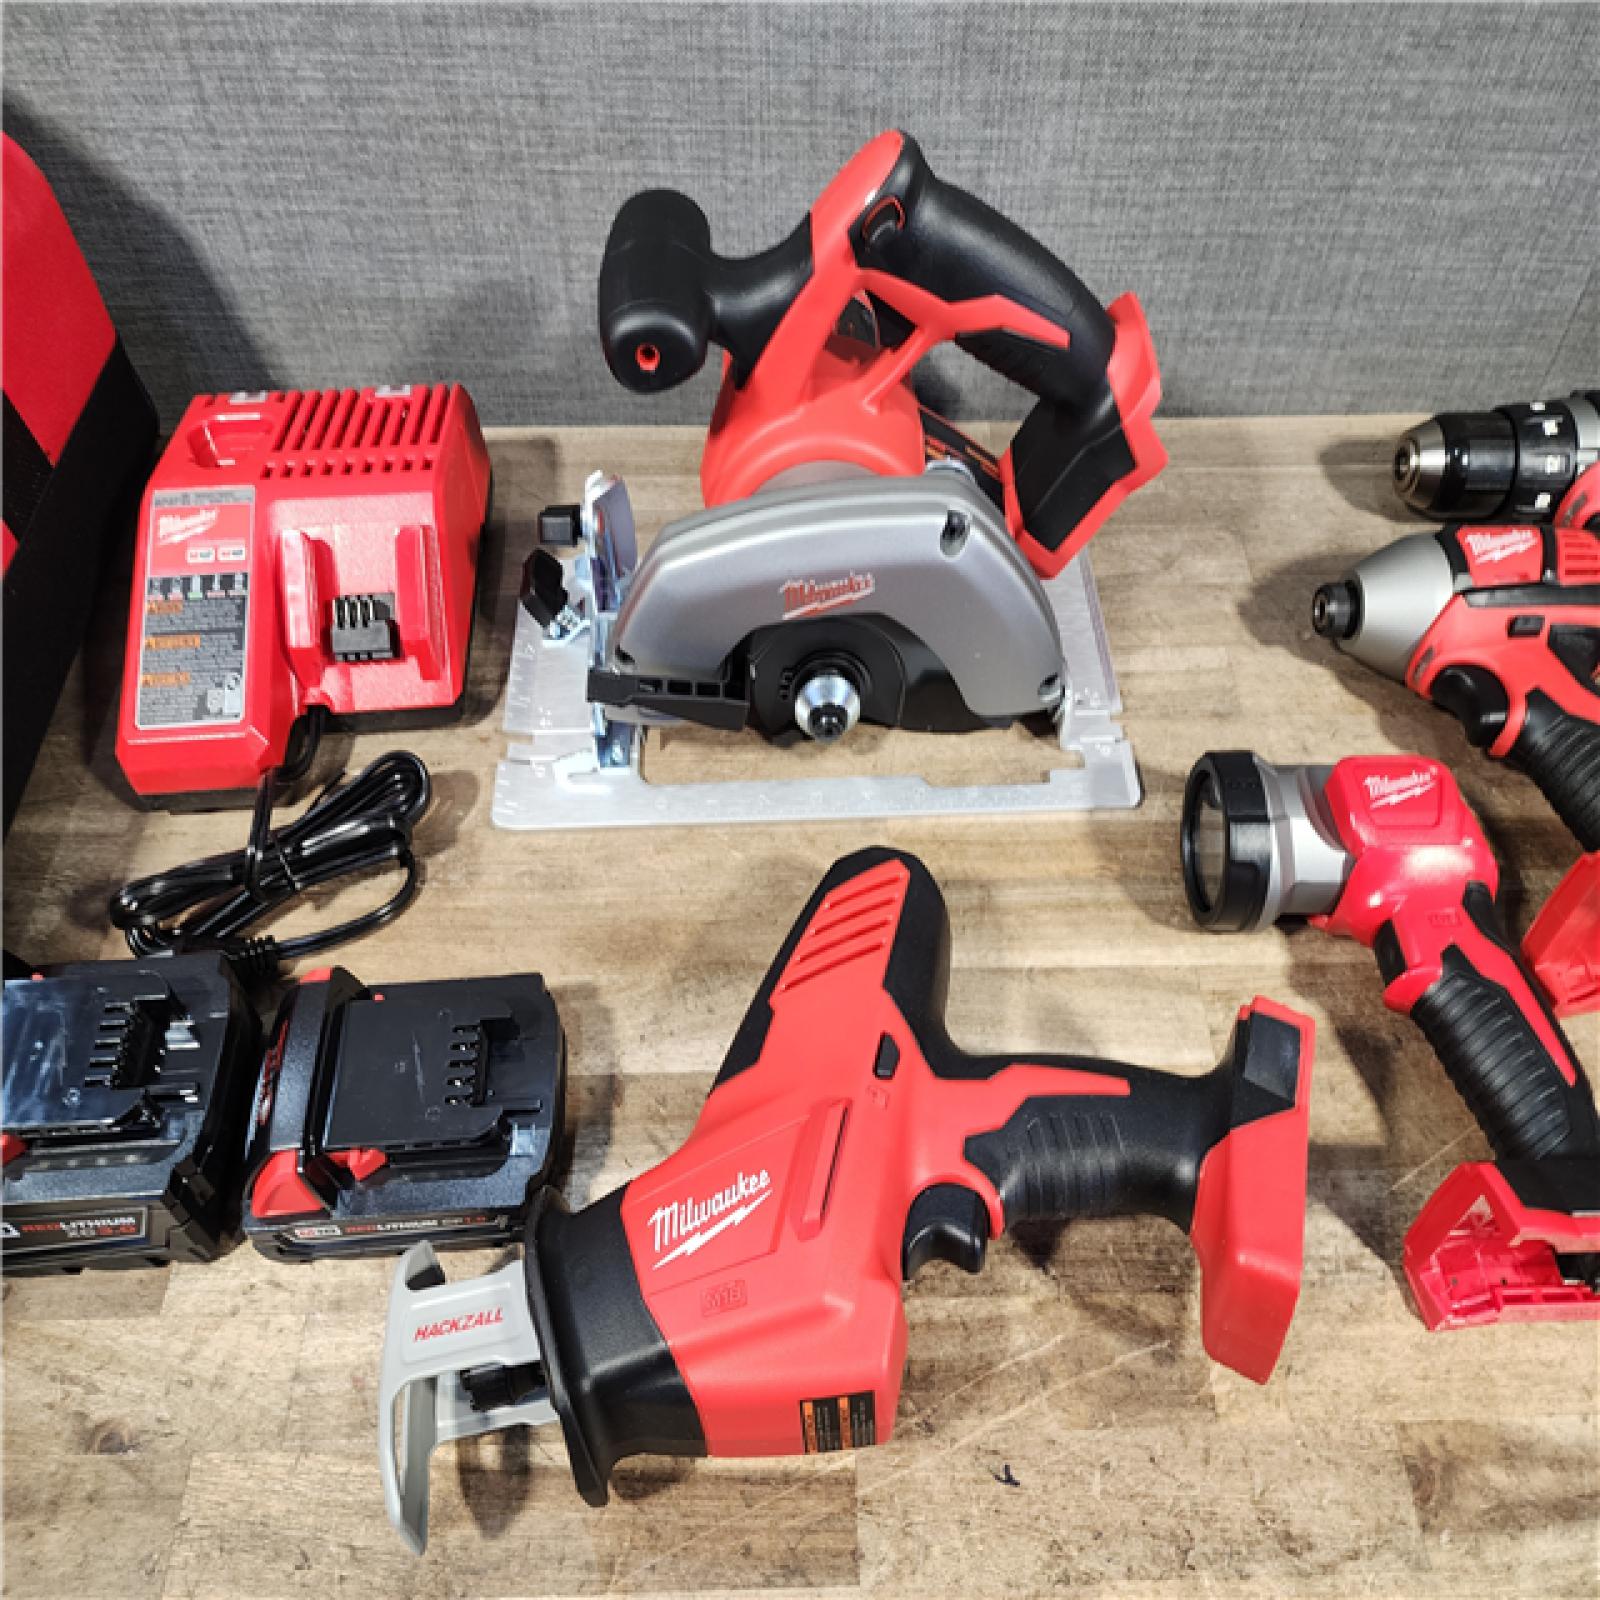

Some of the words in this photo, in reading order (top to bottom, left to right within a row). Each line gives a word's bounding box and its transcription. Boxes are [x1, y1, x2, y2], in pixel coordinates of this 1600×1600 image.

[1464, 529, 1532, 556] Milwaukee
[779, 570, 876, 613] Milwaukee
[1363, 770, 1431, 800] Milwaukee
[648, 1169, 771, 1253] Milwaukee
[414, 1306, 503, 1342] HACKZALL
